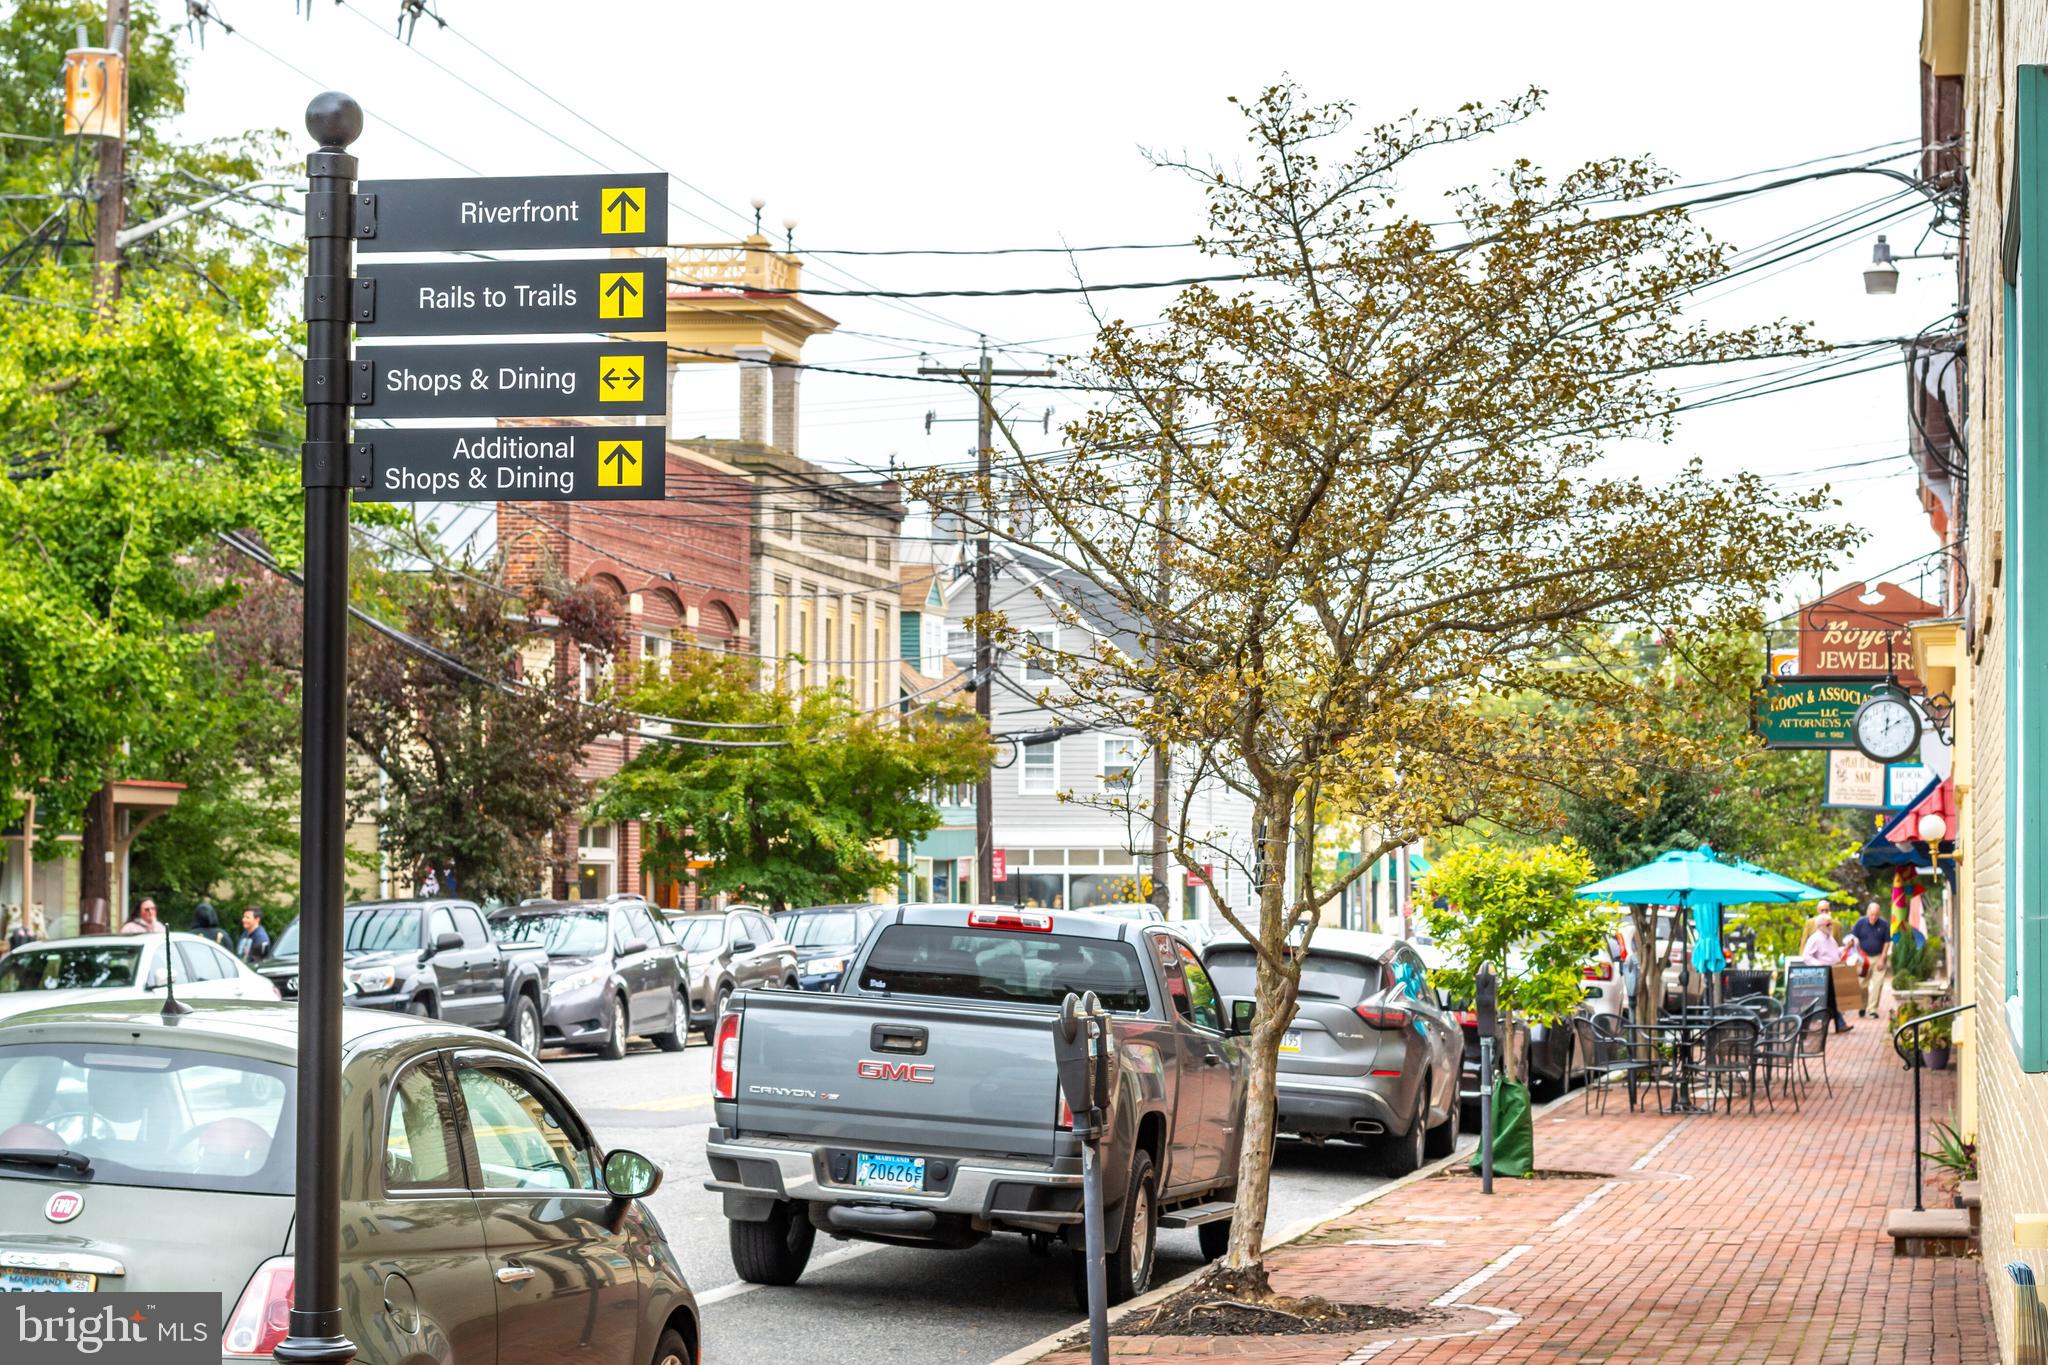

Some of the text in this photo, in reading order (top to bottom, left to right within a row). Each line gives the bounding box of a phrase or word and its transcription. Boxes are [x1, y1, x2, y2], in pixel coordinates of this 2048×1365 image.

[461, 199, 579, 224] Riverfront
[419, 284, 577, 309] Rails to Trails
[386, 367, 577, 396] Shops & Dining
[453, 436, 575, 460] Additional
[384, 465, 575, 494] Shops & Dining
[1816, 651, 1914, 670] JEWELER
[1807, 690, 1815, 705] &
[1818, 686, 1874, 705] ASSOCIA
[1779, 718, 1842, 728] ATTORNEYS
[857, 1059, 935, 1084] GMC
[749, 1085, 817, 1098] CANYON
[875, 1154, 910, 1163] MARYLAND
[869, 1162, 913, 1183] 20626
[52, 1198, 78, 1214] FIAT
[9, 1275, 62, 1287] MARYLAND
